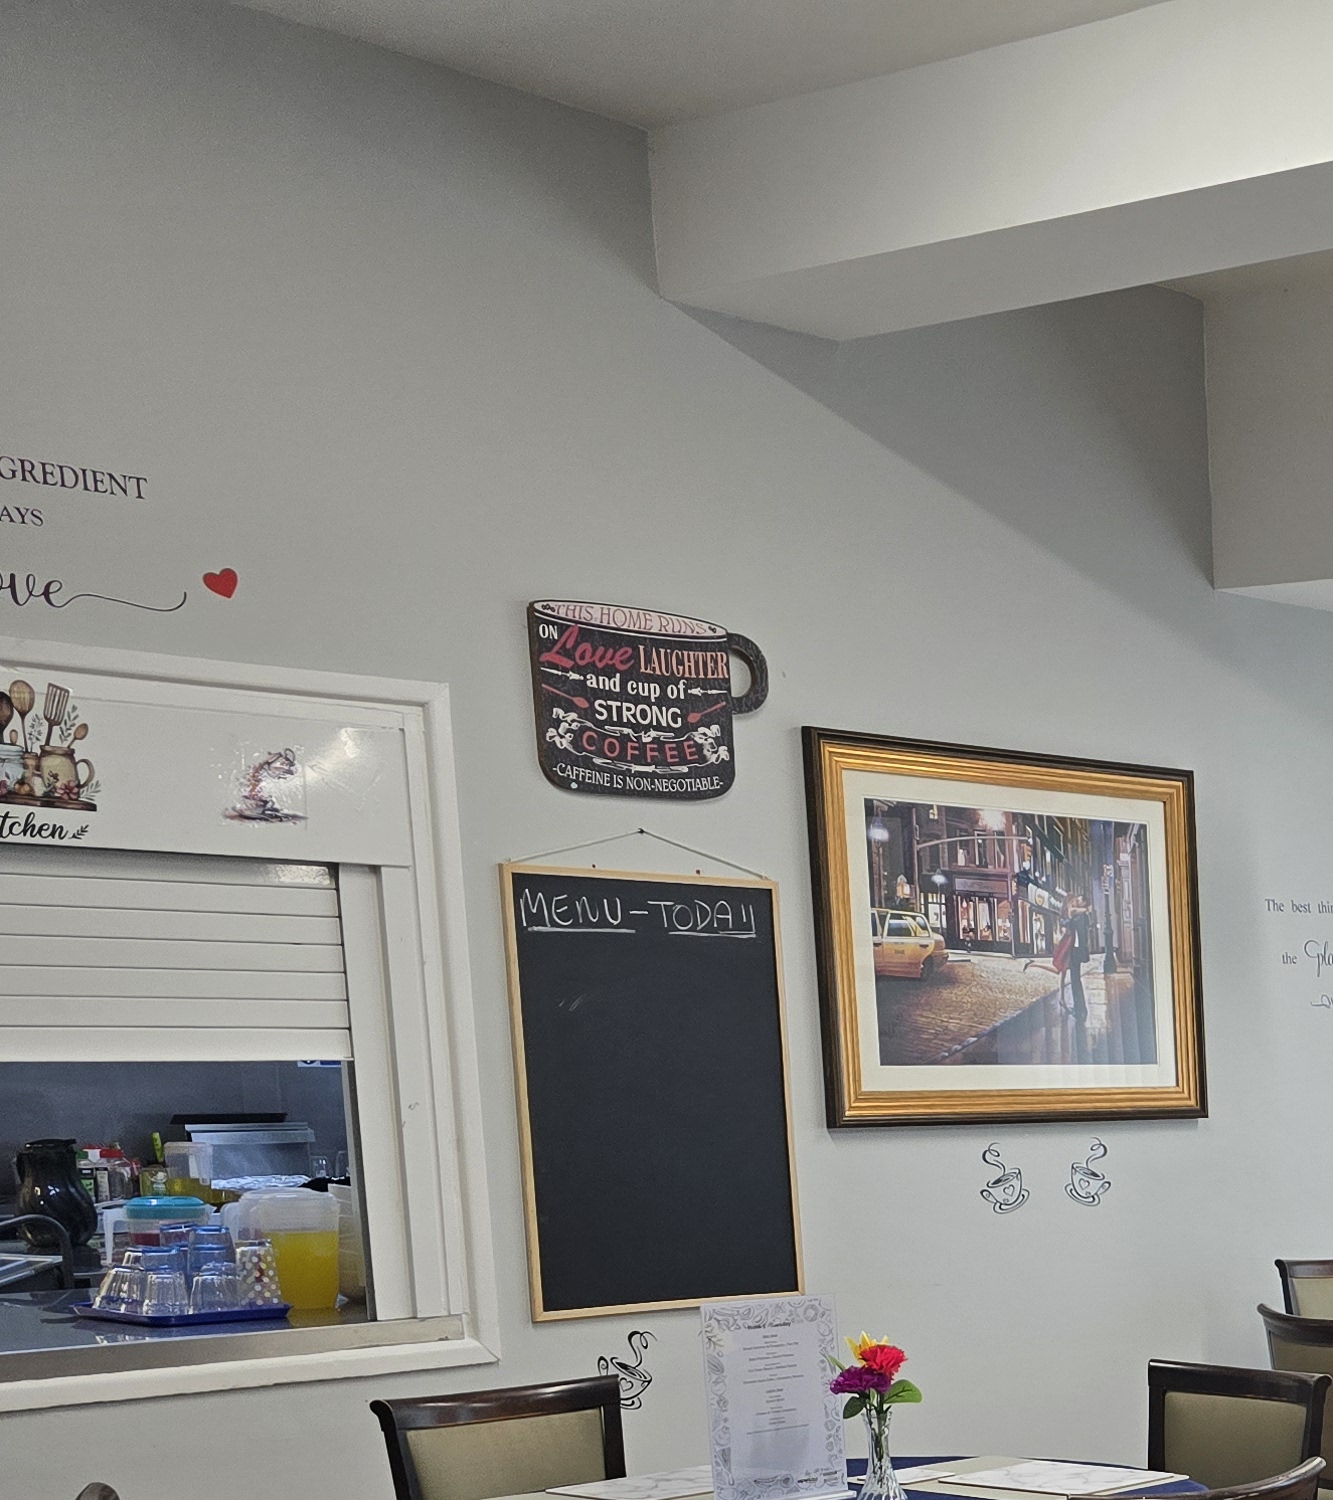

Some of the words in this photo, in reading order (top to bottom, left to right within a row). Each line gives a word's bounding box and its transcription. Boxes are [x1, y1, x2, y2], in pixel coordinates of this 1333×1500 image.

[539, 624, 558, 640] ON
[555, 604, 594, 622] THIS
[600, 607, 653, 632] HOME
[658, 616, 707, 635] RUNS
[539, 624, 634, 671] Love
[638, 645, 729, 679] LAUGHTER
[586, 673, 620, 692] and
[627, 681, 660, 702] cup
[667, 680, 688, 699] of
[595, 700, 682, 728] STRONG
[582, 731, 699, 763] COFFEE
[613, 775, 624, 789] IS
[1265, 899, 1284, 913] The
[1291, 900, 1311, 913] best
[1282, 952, 1297, 964] the
